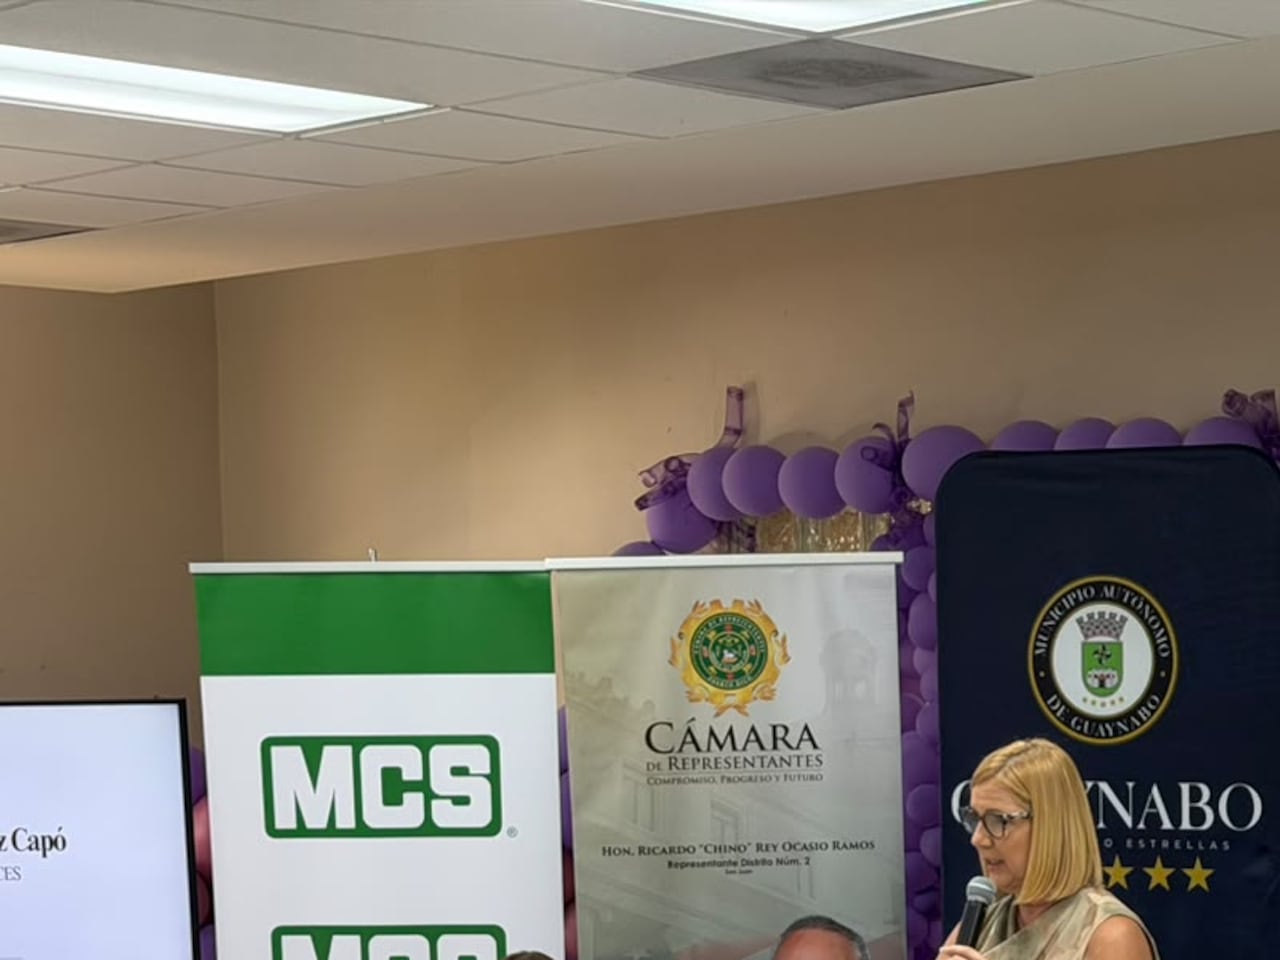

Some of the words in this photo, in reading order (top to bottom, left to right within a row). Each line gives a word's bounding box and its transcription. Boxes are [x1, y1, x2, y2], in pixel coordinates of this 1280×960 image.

[1034, 585, 1096, 657] MUNICIPIO
[1100, 584, 1171, 658] AUTÓNOMO
[1046, 694, 1070, 721] DE
[1069, 695, 1161, 738] GUAYNABO
[644, 716, 823, 755] CÁMARA
[667, 754, 824, 772] REPRESENTANTES
[269, 743, 493, 830] MCS
[11, 826, 67, 858] Capó
[601, 845, 634, 857] HON.
[637, 843, 696, 856] RICARDO
[756, 841, 778, 853] REY
[782, 841, 829, 853] OCASIO
[832, 839, 875, 851] RAMOS
[1126, 838, 1231, 851] ESTRELLAS
[0, 865, 22, 881] ES
[667, 859, 738, 871] Representante
[740, 857, 773, 868] Distrito
[804, 856, 811, 866] 2
